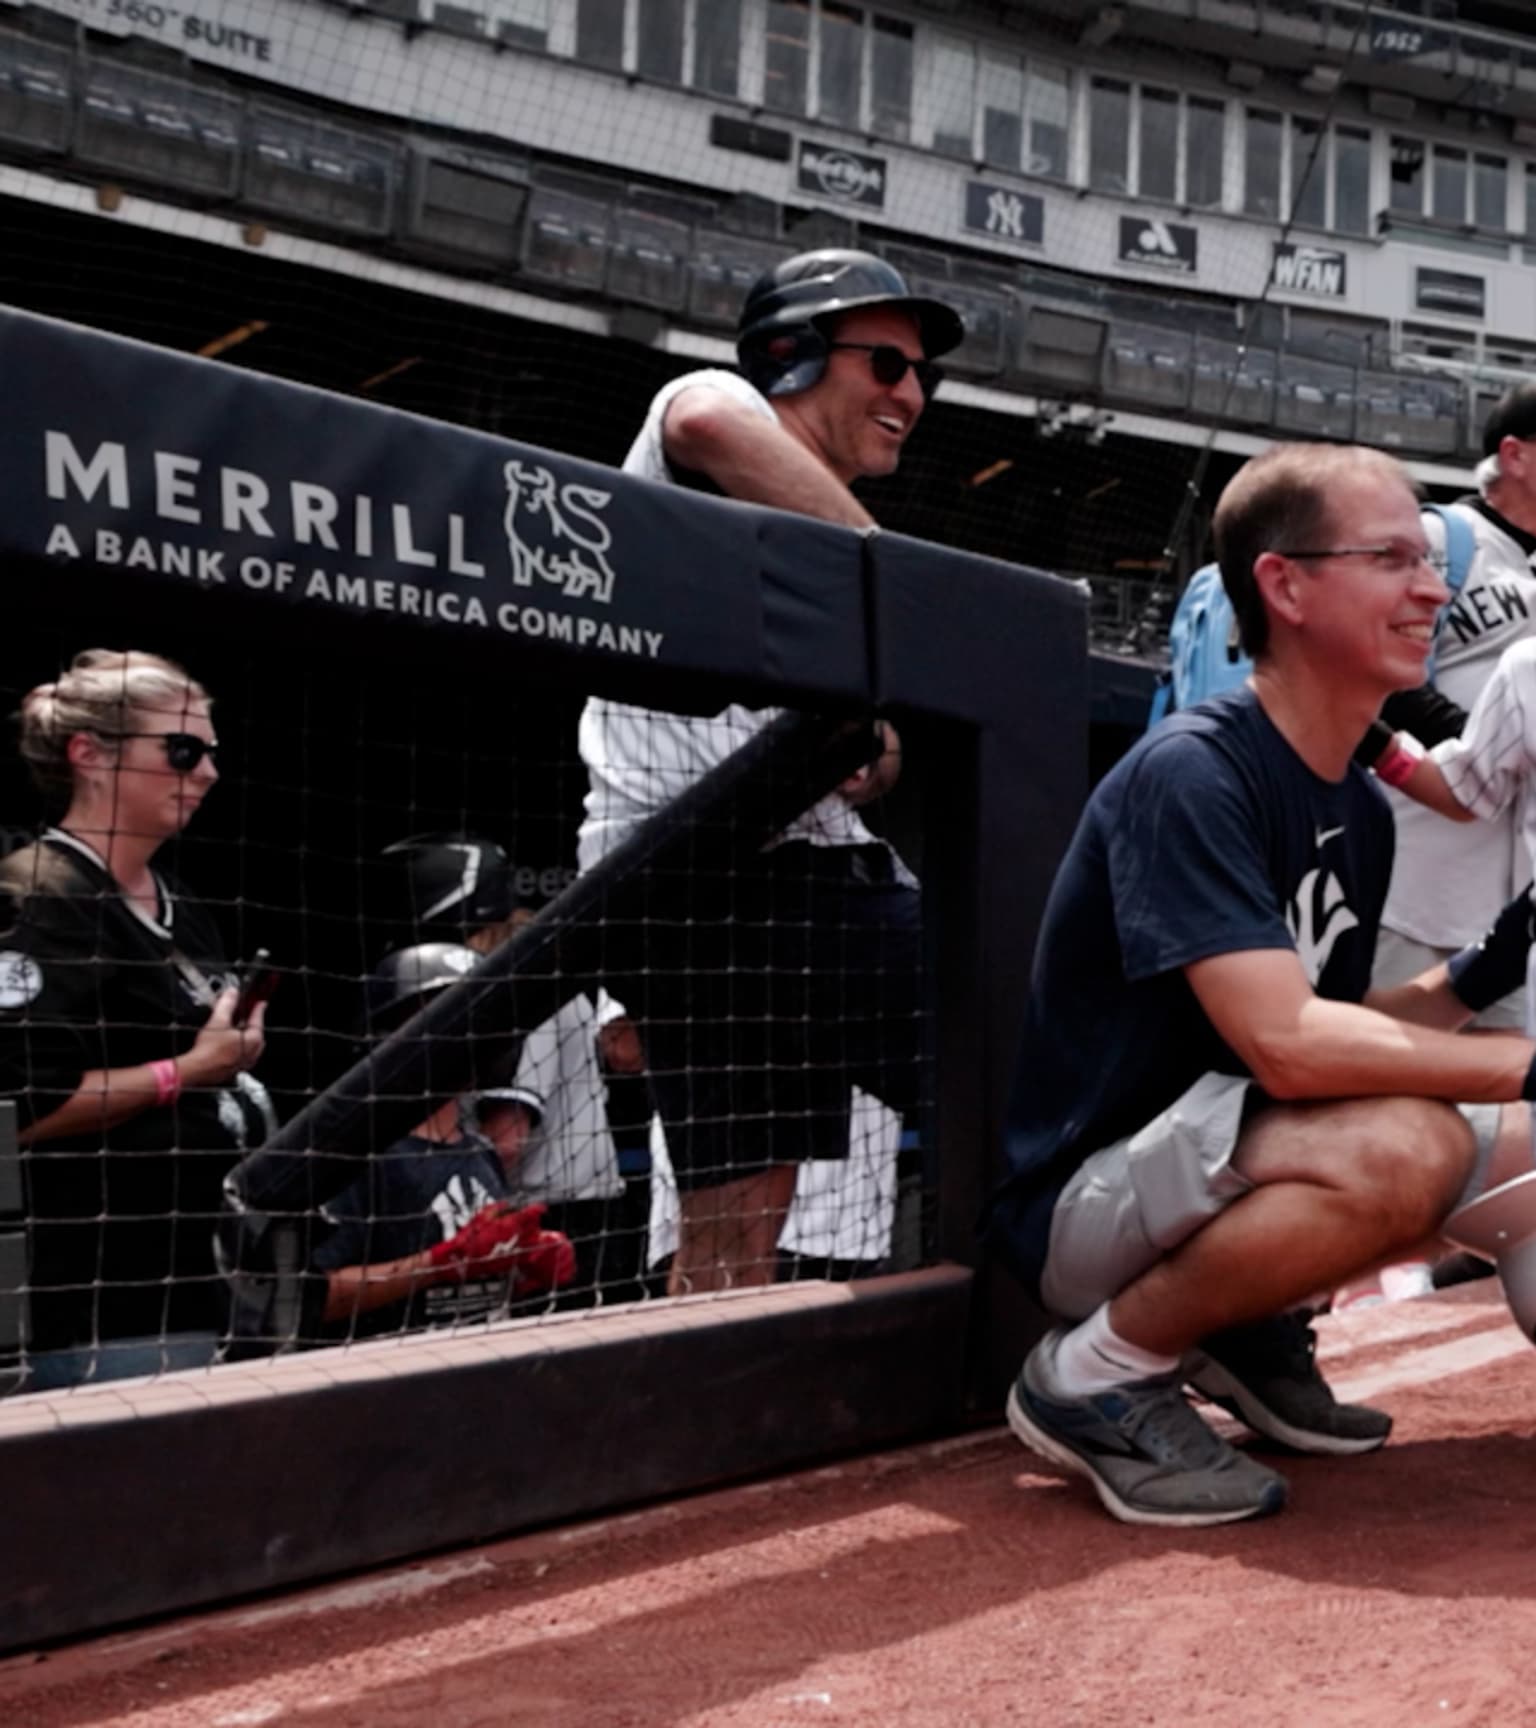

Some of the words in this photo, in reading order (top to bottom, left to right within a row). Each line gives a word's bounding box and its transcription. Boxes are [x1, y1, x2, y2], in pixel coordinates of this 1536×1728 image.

[183, 16, 272, 62] SUITE
[1274, 252, 1342, 295] WFAN
[45, 429, 486, 578] MERRILL
[45, 523, 81, 558] A
[95, 529, 226, 583] BANK
[240, 557, 296, 593] OF
[306, 568, 489, 627] AMERICA
[497, 603, 663, 658] COMPANY
[1448, 583, 1529, 645] NEW
